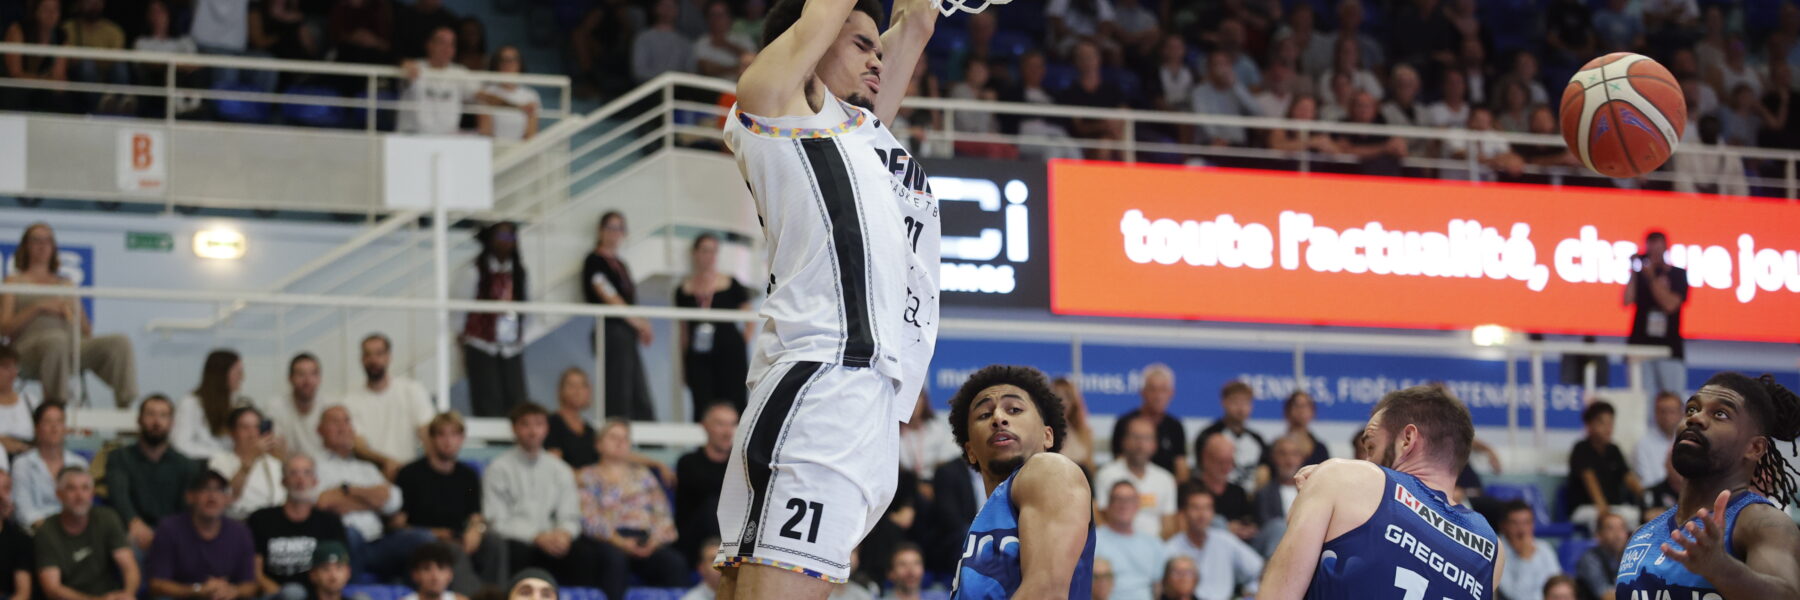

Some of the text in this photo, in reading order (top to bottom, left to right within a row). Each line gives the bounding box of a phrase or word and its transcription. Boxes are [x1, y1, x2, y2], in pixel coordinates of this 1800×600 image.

[132, 133, 154, 170] B
[1120, 209, 1273, 269] toute
[1554, 225, 1733, 289] chaue
[779, 497, 824, 544] 21
[1384, 524, 1484, 600] GREGOIRE
